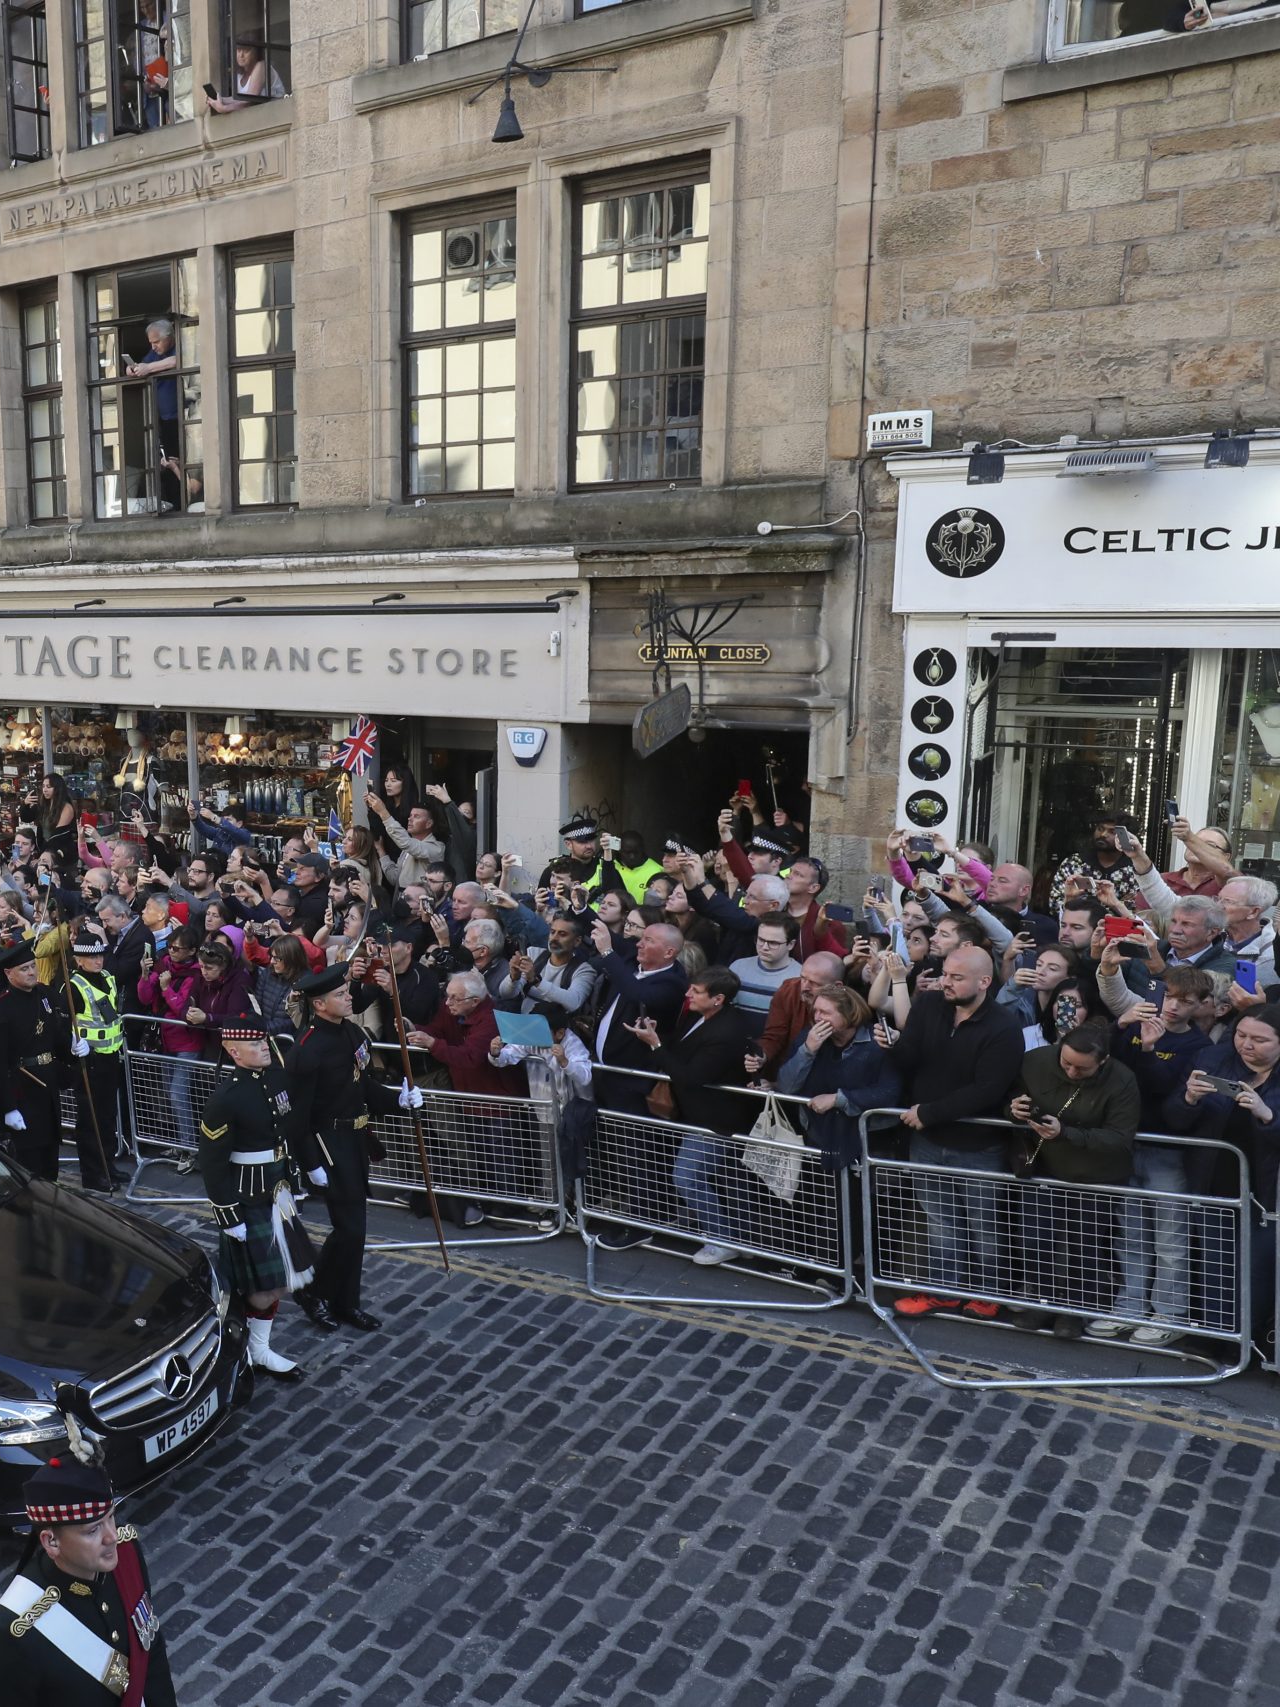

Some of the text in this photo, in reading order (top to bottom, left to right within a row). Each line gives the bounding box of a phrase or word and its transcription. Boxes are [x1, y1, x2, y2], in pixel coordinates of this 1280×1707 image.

[166, 151, 269, 195] CINEMA
[872, 417, 923, 431] IMMS
[1063, 526, 1280, 554] CELTIC J
[153, 645, 364, 674] CLEARANCE
[387, 648, 519, 677] STORE
[719, 648, 762, 660] CLOSE
[515, 733, 533, 743] RG
[157, 1398, 211, 1454] WP 4597
